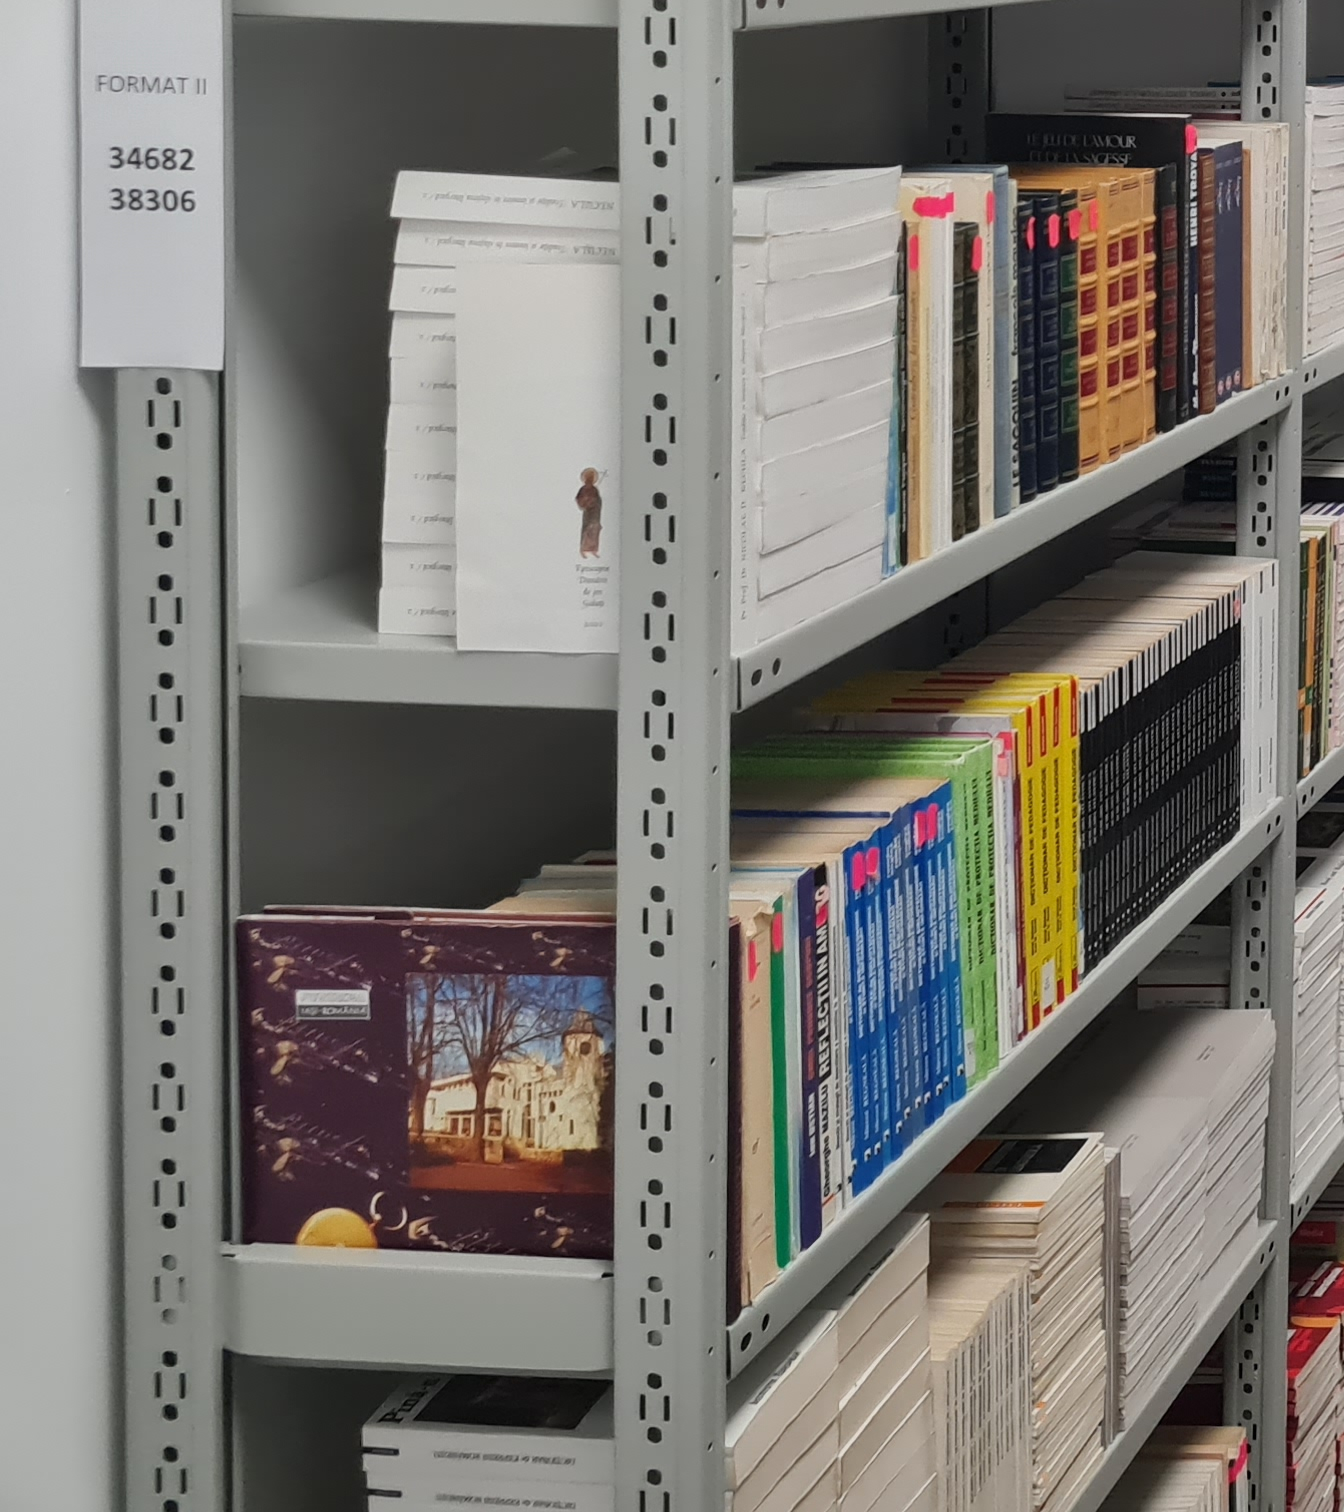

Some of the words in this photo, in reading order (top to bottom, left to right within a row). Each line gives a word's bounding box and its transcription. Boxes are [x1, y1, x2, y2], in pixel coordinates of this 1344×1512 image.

[95, 75, 189, 95] FORMAT
[197, 78, 207, 95] II
[109, 146, 195, 171] 34682
[110, 188, 197, 212] 38306
[1190, 202, 1198, 246] HENRI
[1040, 767, 1048, 824] PEDAGOGIE
[819, 1084, 829, 1133] MAZILU
[822, 1136, 832, 1197] Gheorghe
